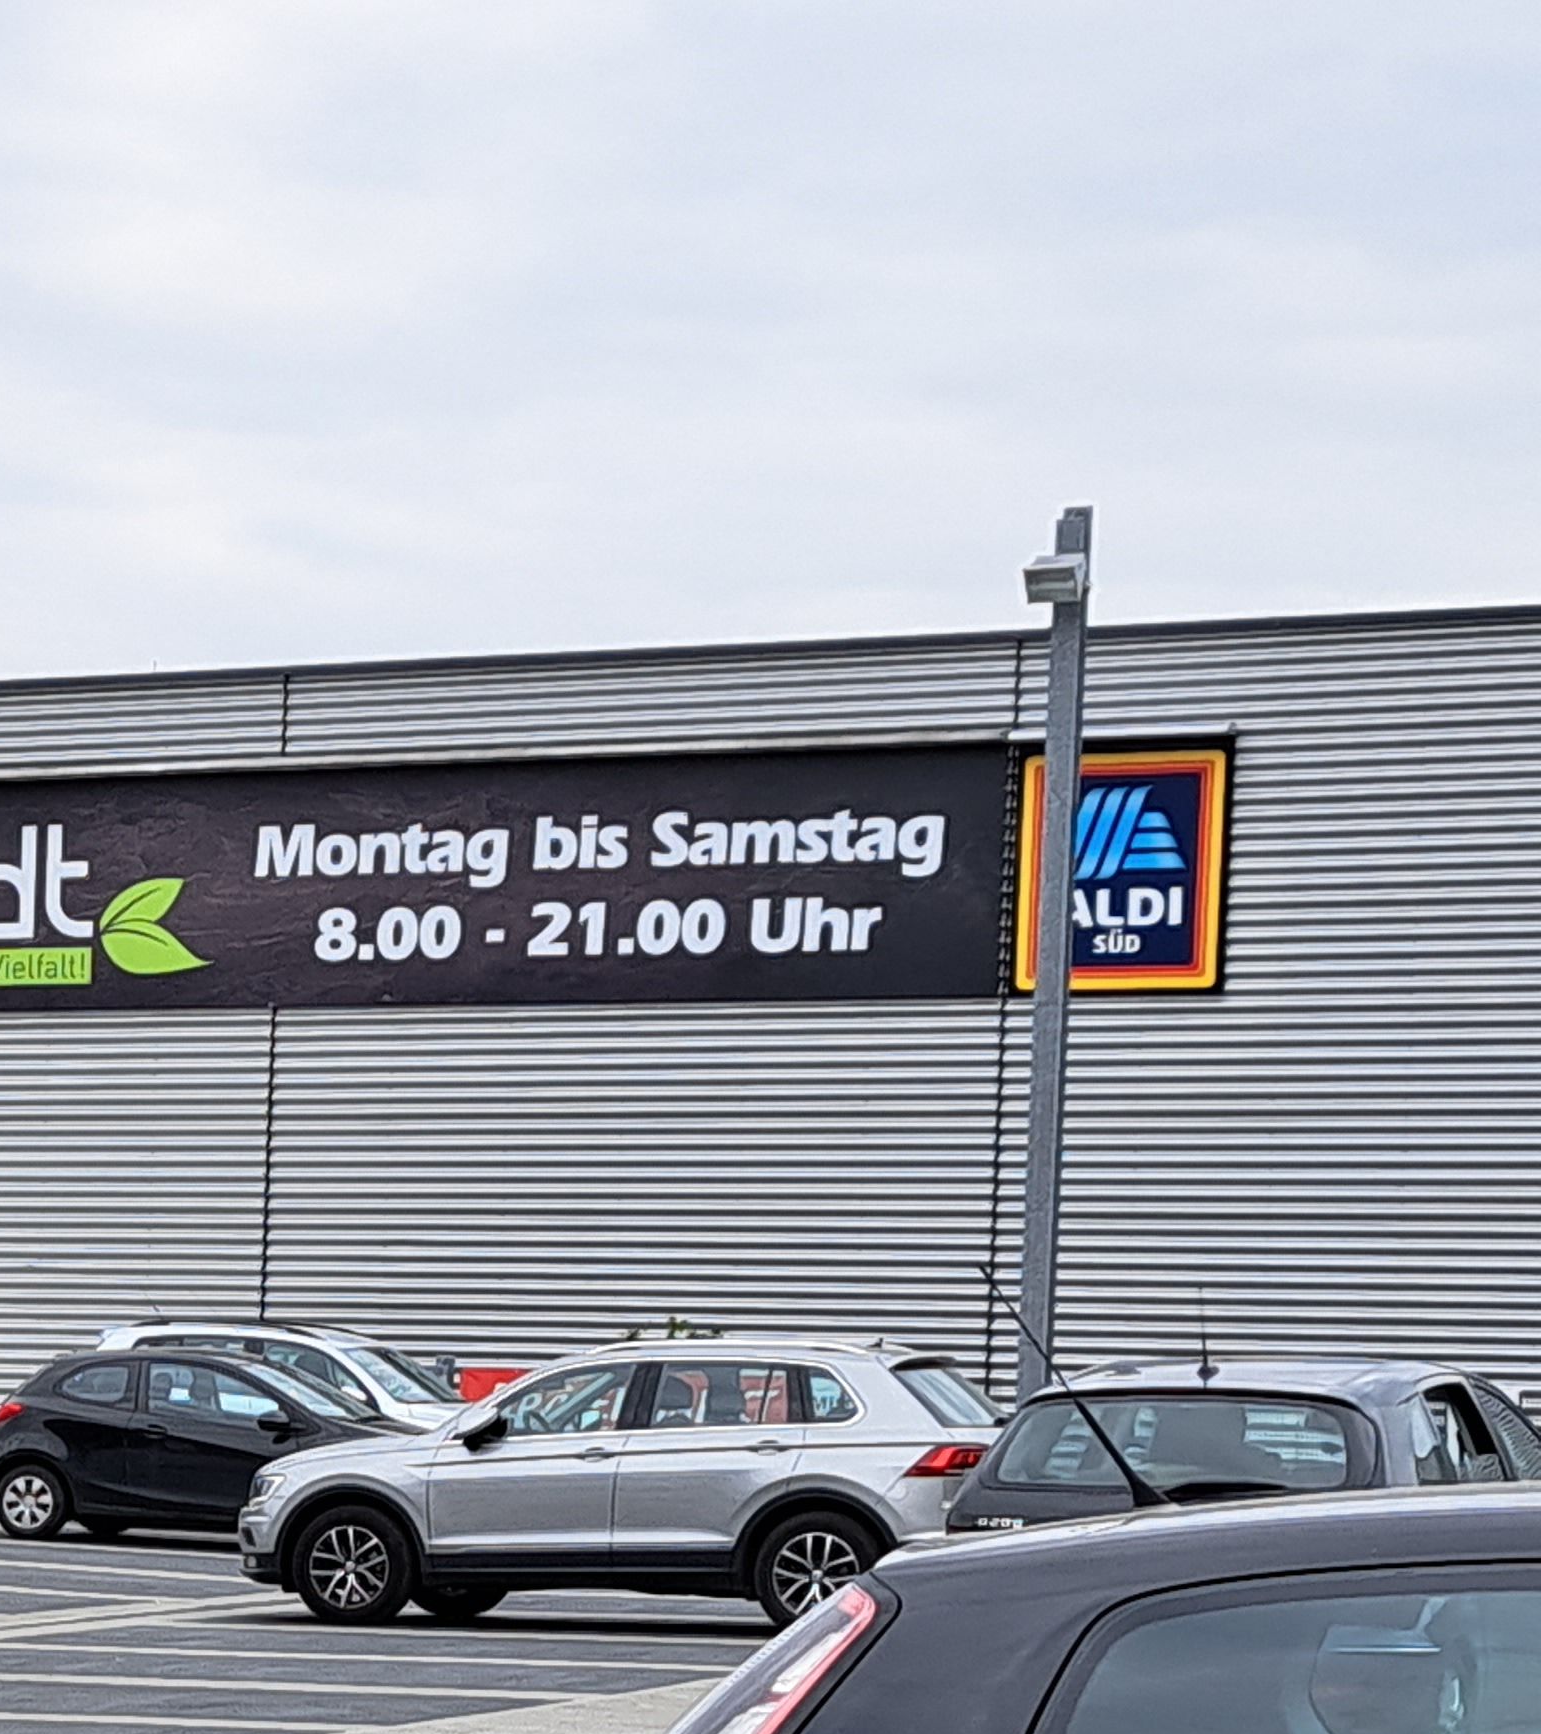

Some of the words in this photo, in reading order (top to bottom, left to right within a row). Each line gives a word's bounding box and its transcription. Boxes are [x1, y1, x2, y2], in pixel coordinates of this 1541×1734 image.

[253, 820, 510, 888] Montag
[532, 813, 629, 872] bis
[649, 810, 947, 878] Samstag
[314, 904, 463, 963] 8.00
[485, 927, 507, 944] -
[525, 899, 727, 958] 21.00
[749, 896, 884, 954] Uhr
[1092, 929, 1141, 954] SÜD
